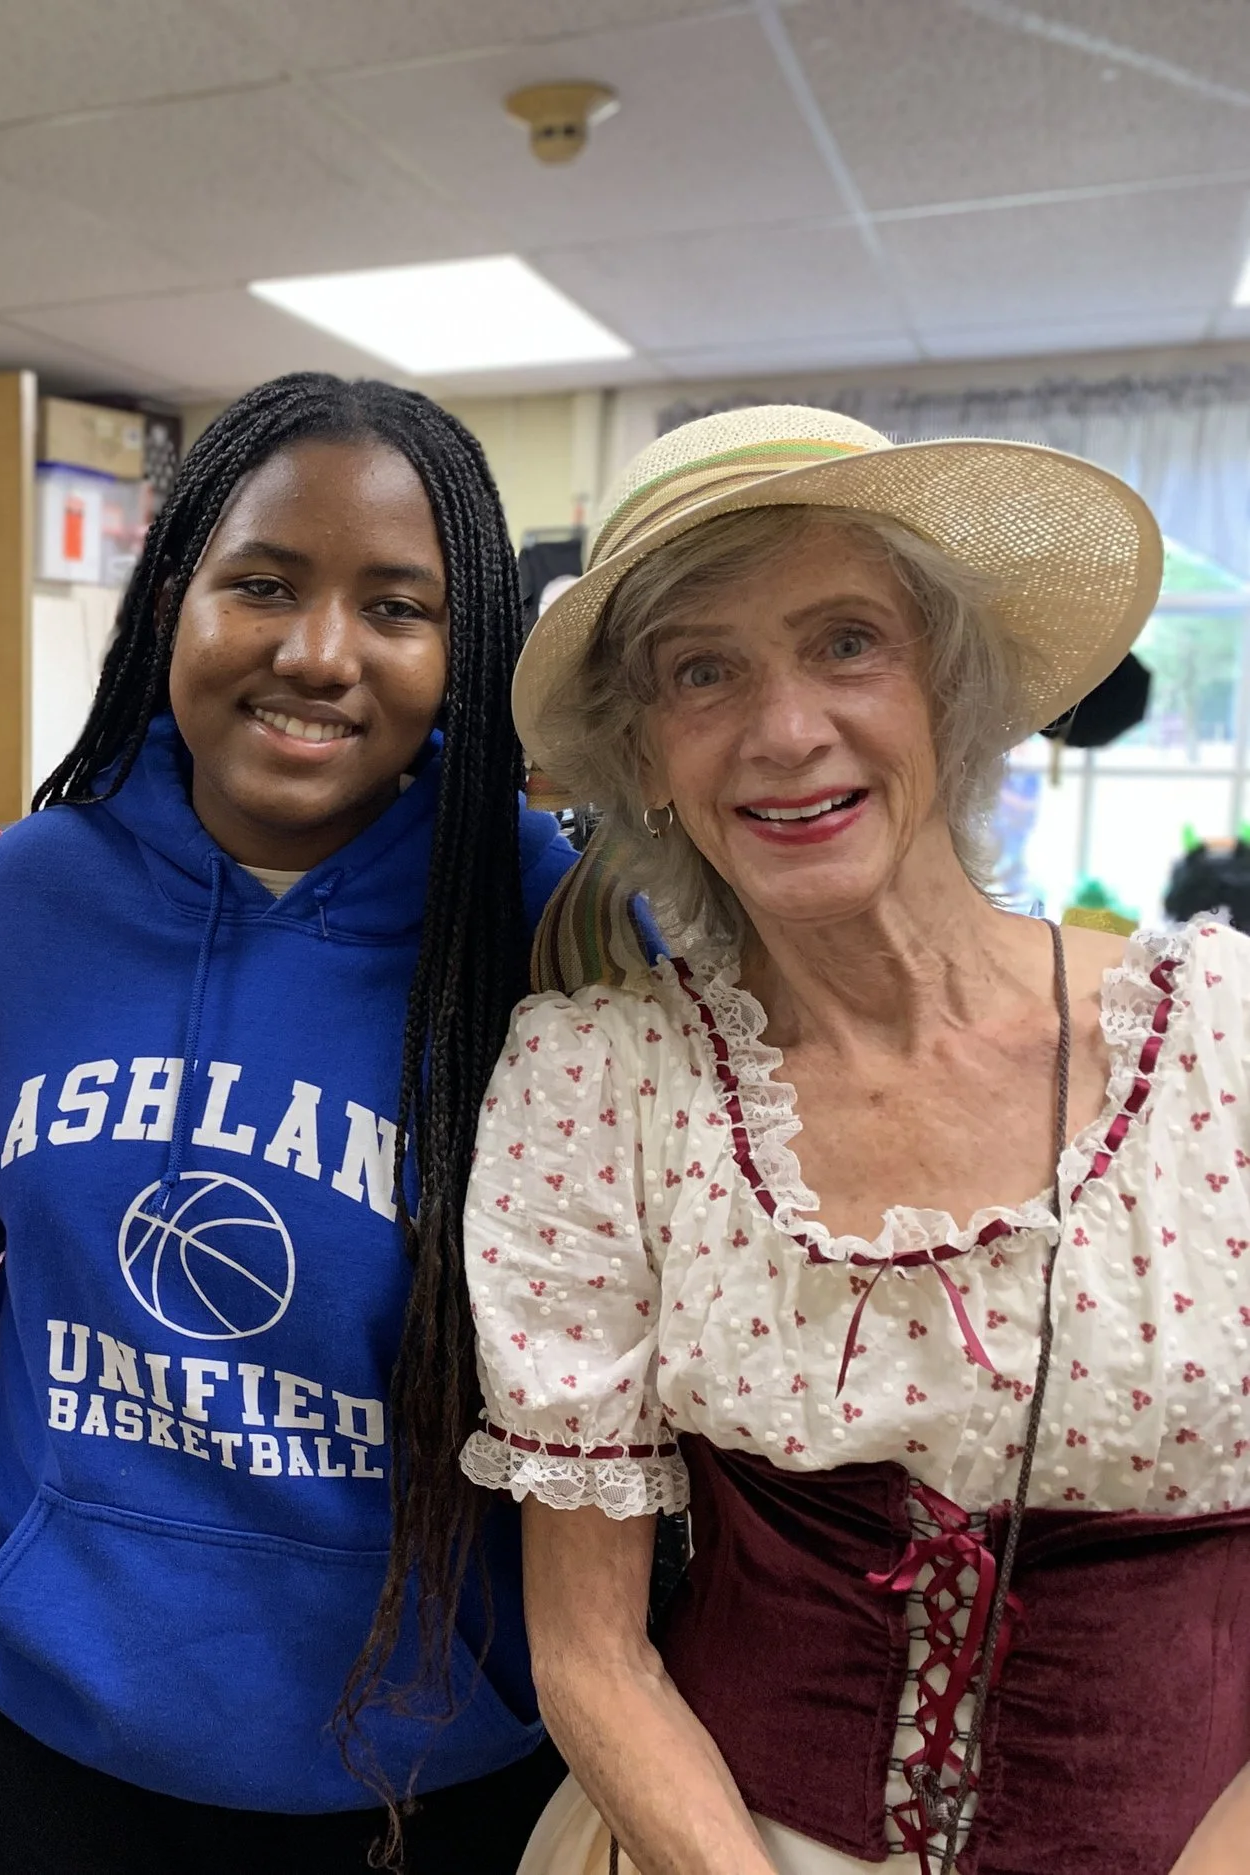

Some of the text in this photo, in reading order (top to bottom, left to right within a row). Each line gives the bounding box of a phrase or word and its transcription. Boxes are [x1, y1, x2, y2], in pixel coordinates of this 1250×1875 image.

[0, 1057, 419, 1224] ASHLAN
[47, 1319, 385, 1446] UNIFIED
[47, 1387, 383, 1479] BASKETBALL
